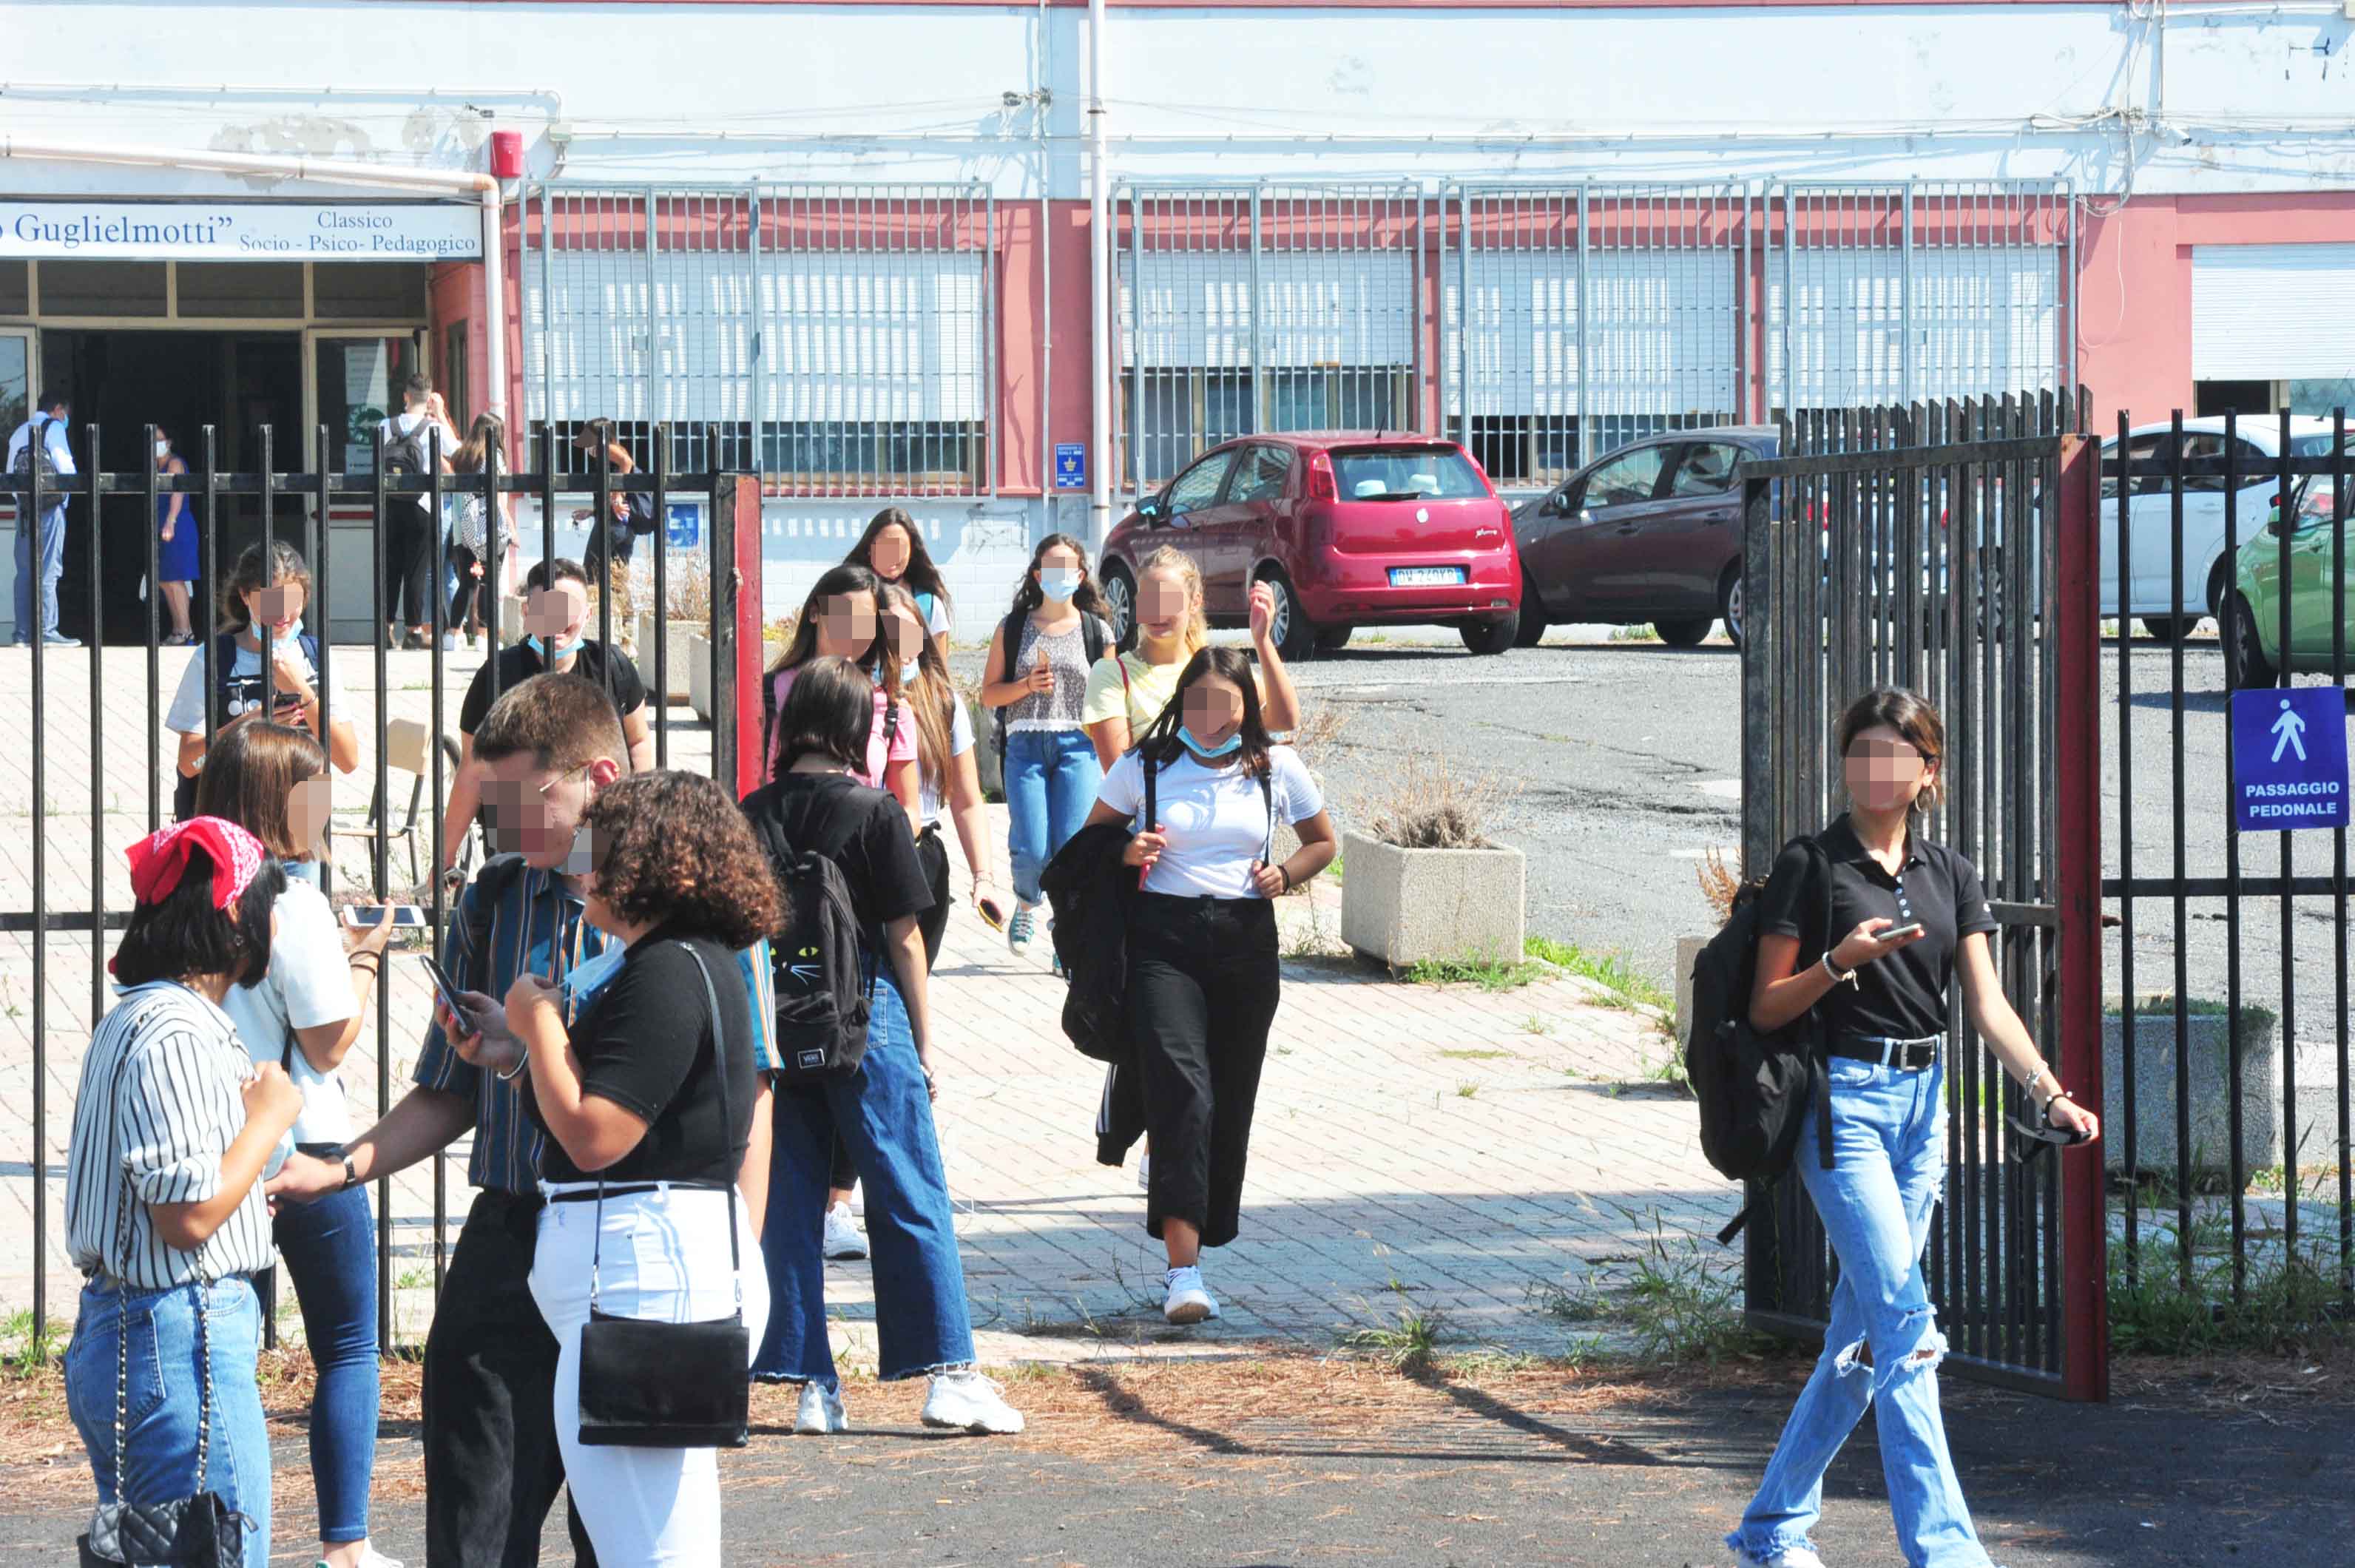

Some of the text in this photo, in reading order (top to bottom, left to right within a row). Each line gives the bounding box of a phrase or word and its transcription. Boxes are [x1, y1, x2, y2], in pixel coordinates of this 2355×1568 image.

[317, 211, 393, 229] Classico
[239, 234, 290, 251] Socio
[373, 234, 476, 254] Pedagogico
[2246, 781, 2339, 797] PASSAGGIO
[2249, 802, 2337, 817] PEDONALE
